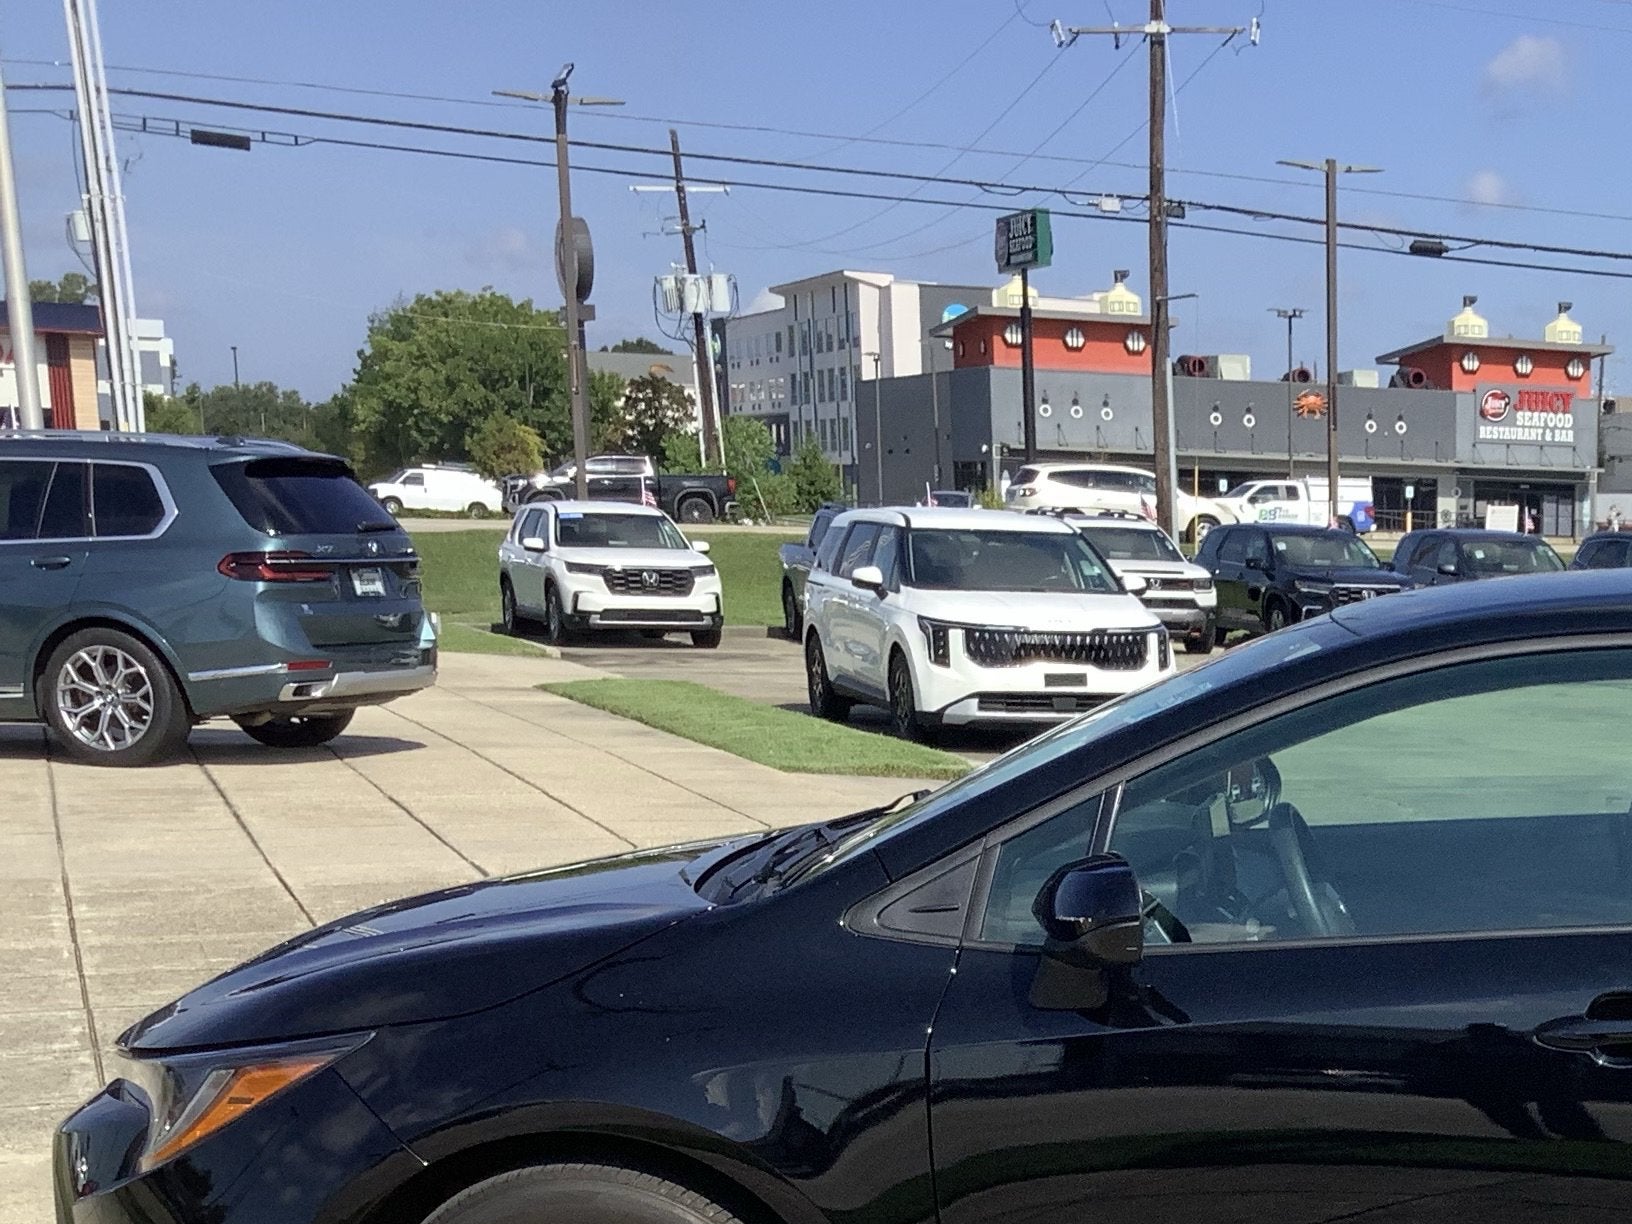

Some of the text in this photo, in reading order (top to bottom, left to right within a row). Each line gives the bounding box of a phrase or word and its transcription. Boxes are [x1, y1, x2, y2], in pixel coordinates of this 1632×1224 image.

[1513, 389, 1574, 413] JUICY
[1516, 411, 1574, 428] SEAFOOD
[1479, 426, 1574, 442] RESTAURANT & BAR
